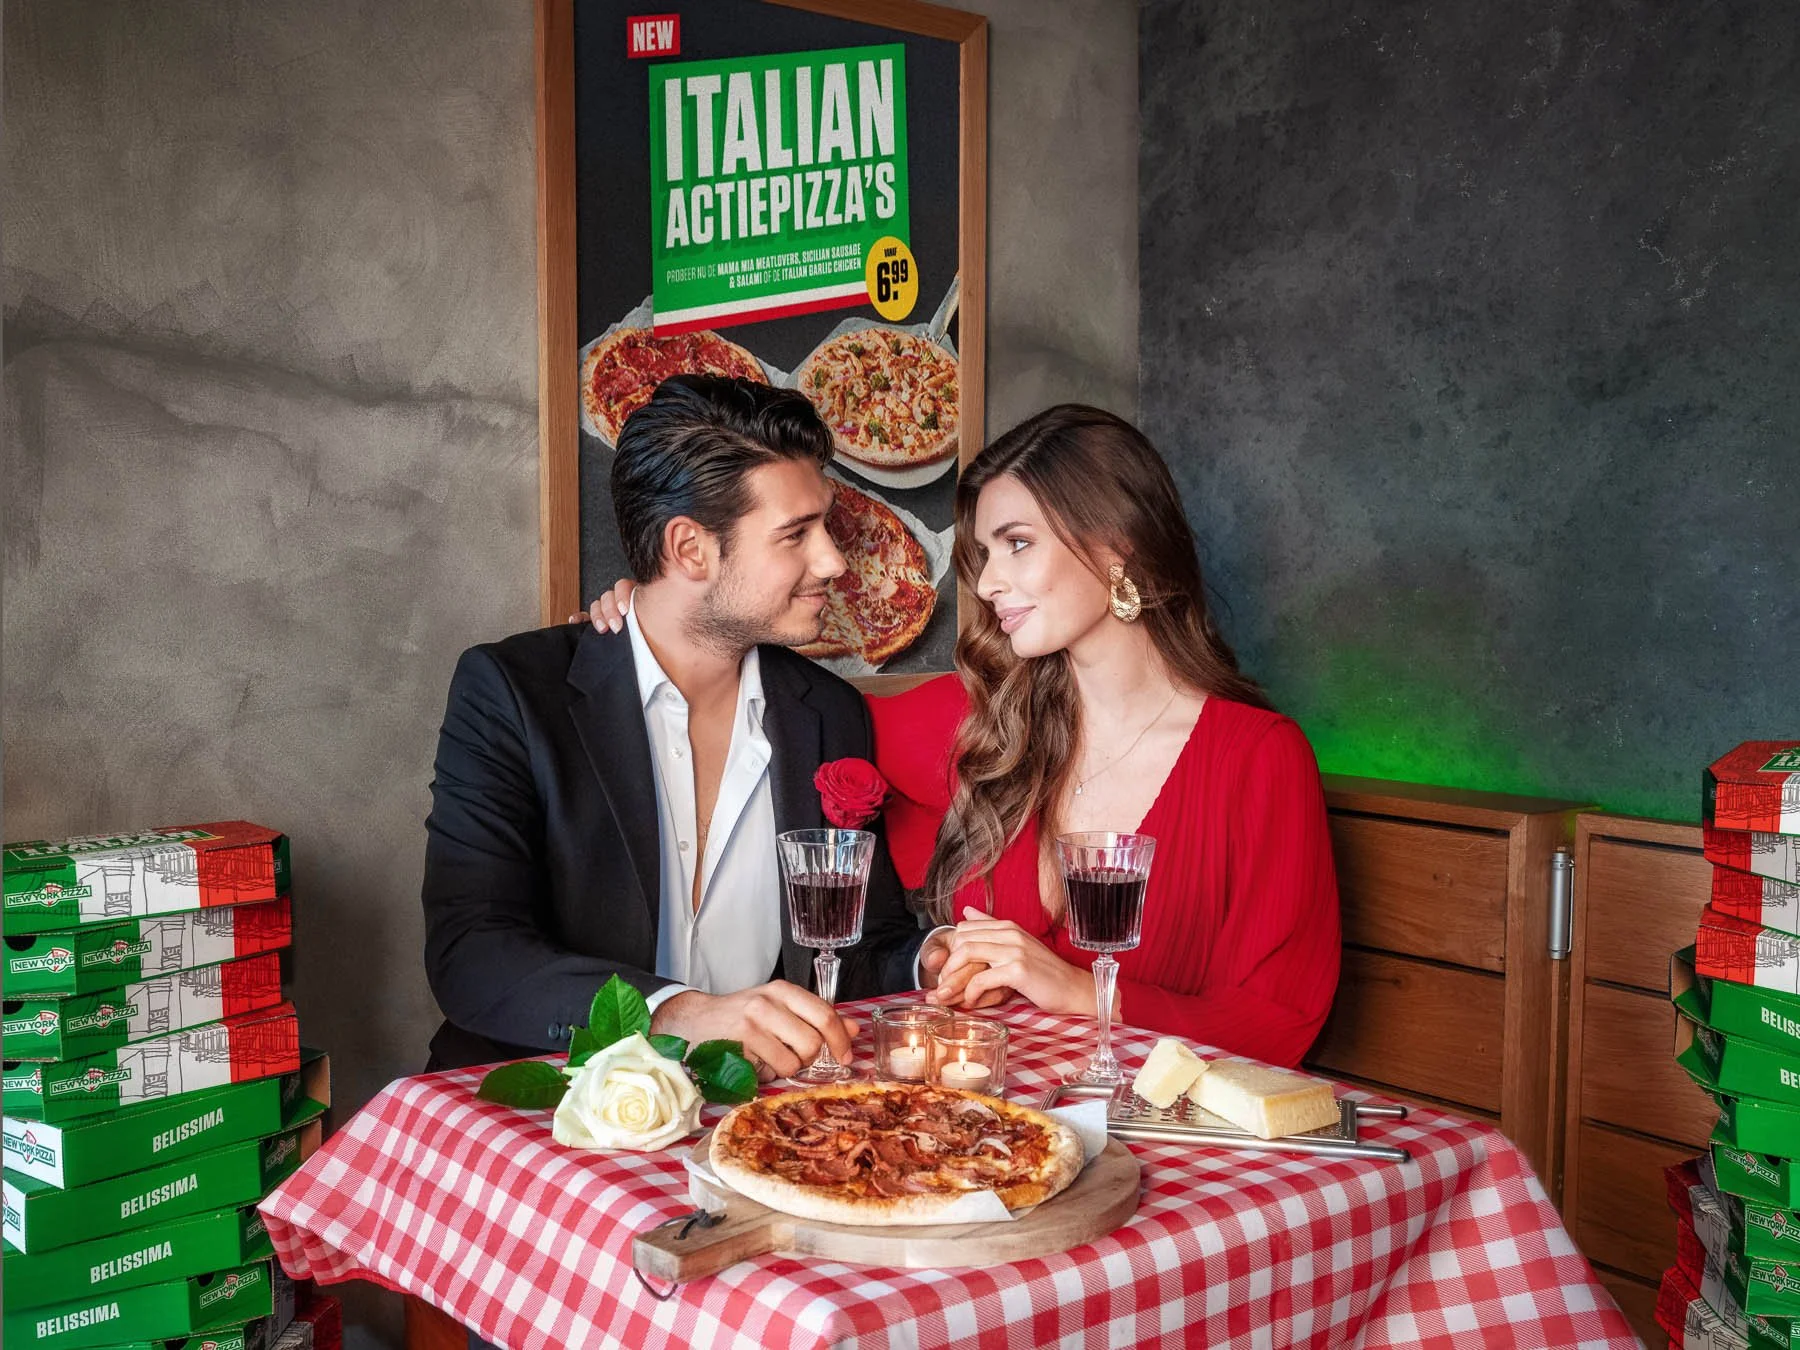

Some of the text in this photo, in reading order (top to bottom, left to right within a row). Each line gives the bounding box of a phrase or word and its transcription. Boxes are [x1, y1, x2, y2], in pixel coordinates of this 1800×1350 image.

[632, 20, 675, 52] NEW
[665, 58, 895, 182] ITALIAN
[665, 161, 896, 249] ACTIEPIZZA'S
[666, 266, 696, 284] PROBEER
[697, 265, 706, 279] NU
[707, 264, 716, 277] DE
[717, 261, 740, 276] MAMA
[741, 259, 754, 272] MIA
[802, 247, 830, 263] SICILIAN
[831, 243, 861, 259] SAUSAGE
[729, 257, 861, 288] & SALAMI OF DE ITALIAN GARLIC CHICKEN
[8, 893, 31, 905] NEW
[33, 891, 60, 901] YORK
[61, 887, 89, 898] PIZZA
[14, 960, 39, 970] NEW
[40, 957, 67, 968] YORK
[84, 953, 105, 965] NEW
[105, 949, 126, 960] YORK
[126, 943, 149, 954] PIZZA
[2, 1019, 56, 1033] NEW YORK
[69, 1018, 89, 1029] NEW
[90, 1014, 112, 1024] YORK
[112, 1007, 136, 1018] PIZZA
[2, 1078, 26, 1088] NEW
[53, 1080, 75, 1092] NEW
[76, 1075, 102, 1087] YORK
[102, 1070, 129, 1082] PIZZA
[152, 1107, 225, 1153] BELISSIMA
[3, 1135, 54, 1163] NEW YORK PIZZA
[120, 1173, 198, 1219] BELISSIMA
[1750, 1212, 1765, 1226] NEW
[1766, 1219, 1785, 1233] YORK
[90, 1241, 173, 1284] BELISSIMA
[1750, 1268, 1765, 1280] NEW
[1766, 1274, 1785, 1286] YORK
[202, 1291, 219, 1304] NEW
[219, 1283, 238, 1297] YORK
[238, 1272, 259, 1287] PIZZA
[36, 1302, 120, 1339] BELISSIMA
